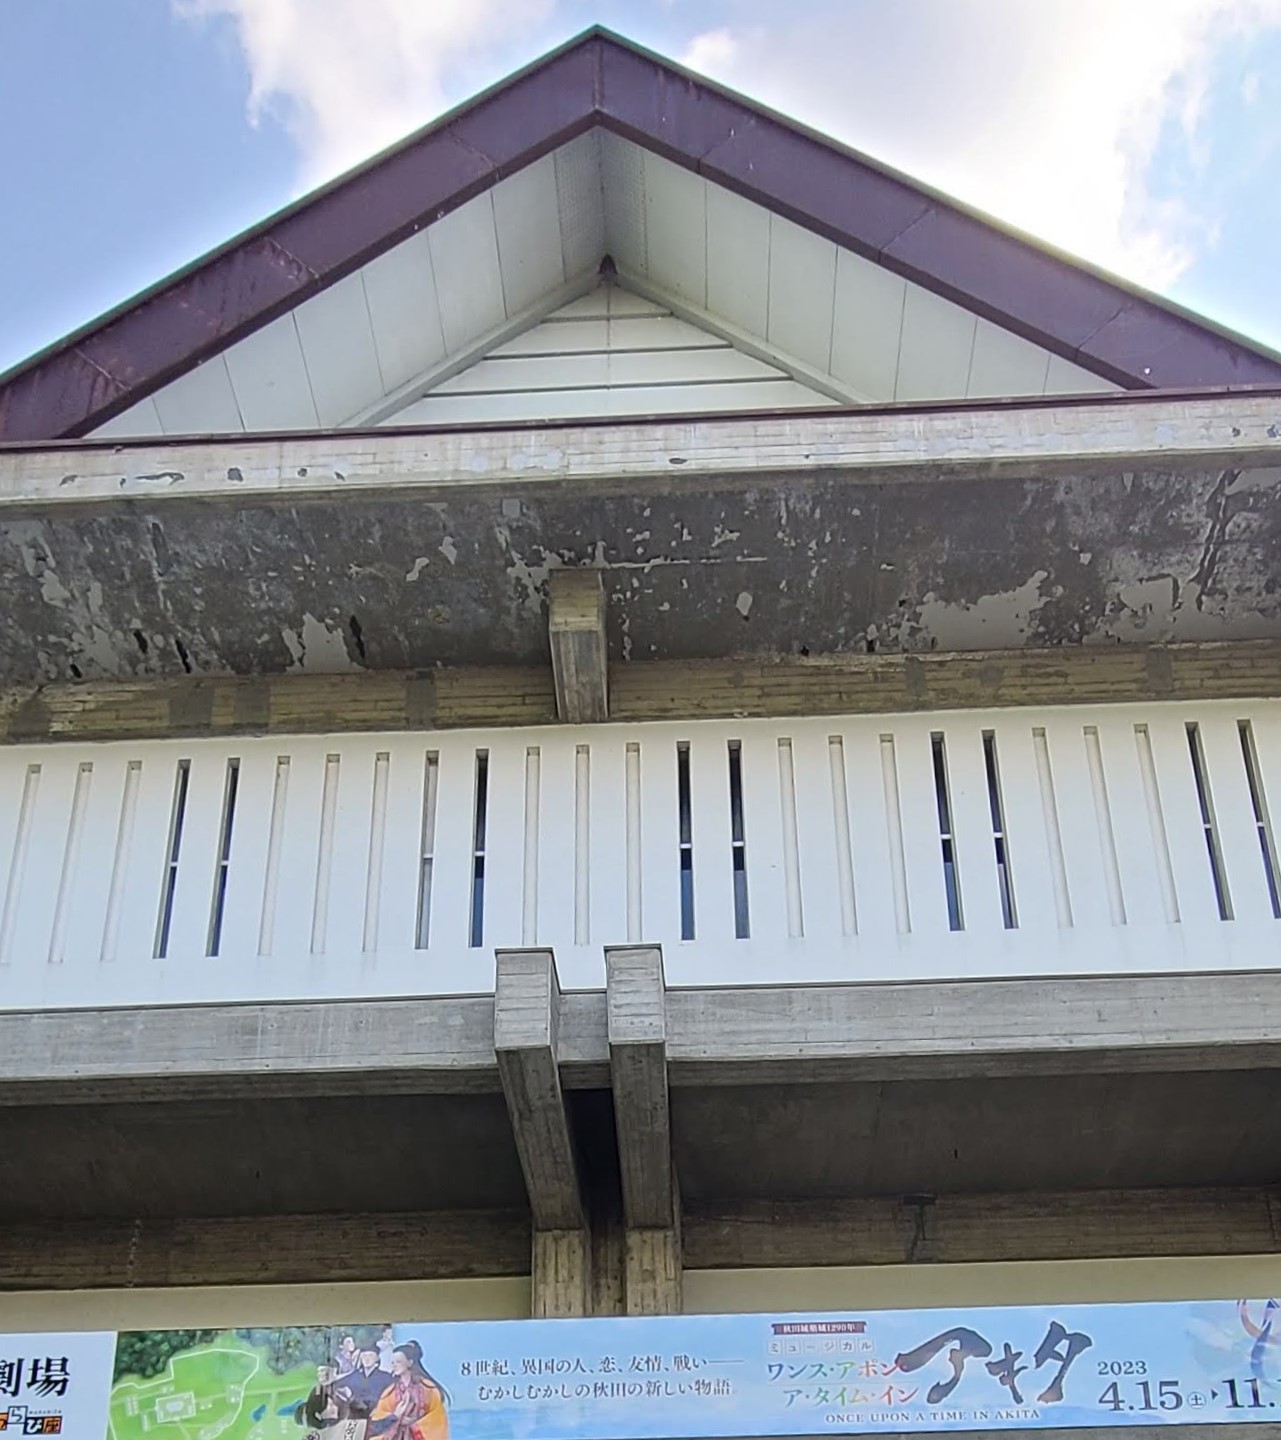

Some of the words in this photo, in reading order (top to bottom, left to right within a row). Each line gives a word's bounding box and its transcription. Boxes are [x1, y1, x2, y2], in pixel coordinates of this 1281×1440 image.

[770, 1341, 872, 1353] ミュージカル
[767, 1359, 900, 1382] ワンス・アポン
[895, 1321, 1093, 1405] アキタ
[1097, 1361, 1148, 1377] 2023
[784, 1384, 919, 1409] ア・タイム・イン
[1098, 1380, 1184, 1412] 4.15
[825, 1413, 865, 1424] ONCE
[870, 1412, 910, 1423] UPON
[917, 1412, 927, 1421] A
[931, 1411, 967, 1421] TIME
[973, 1410, 989, 1420] IN
[994, 1409, 1040, 1419] AKITA
